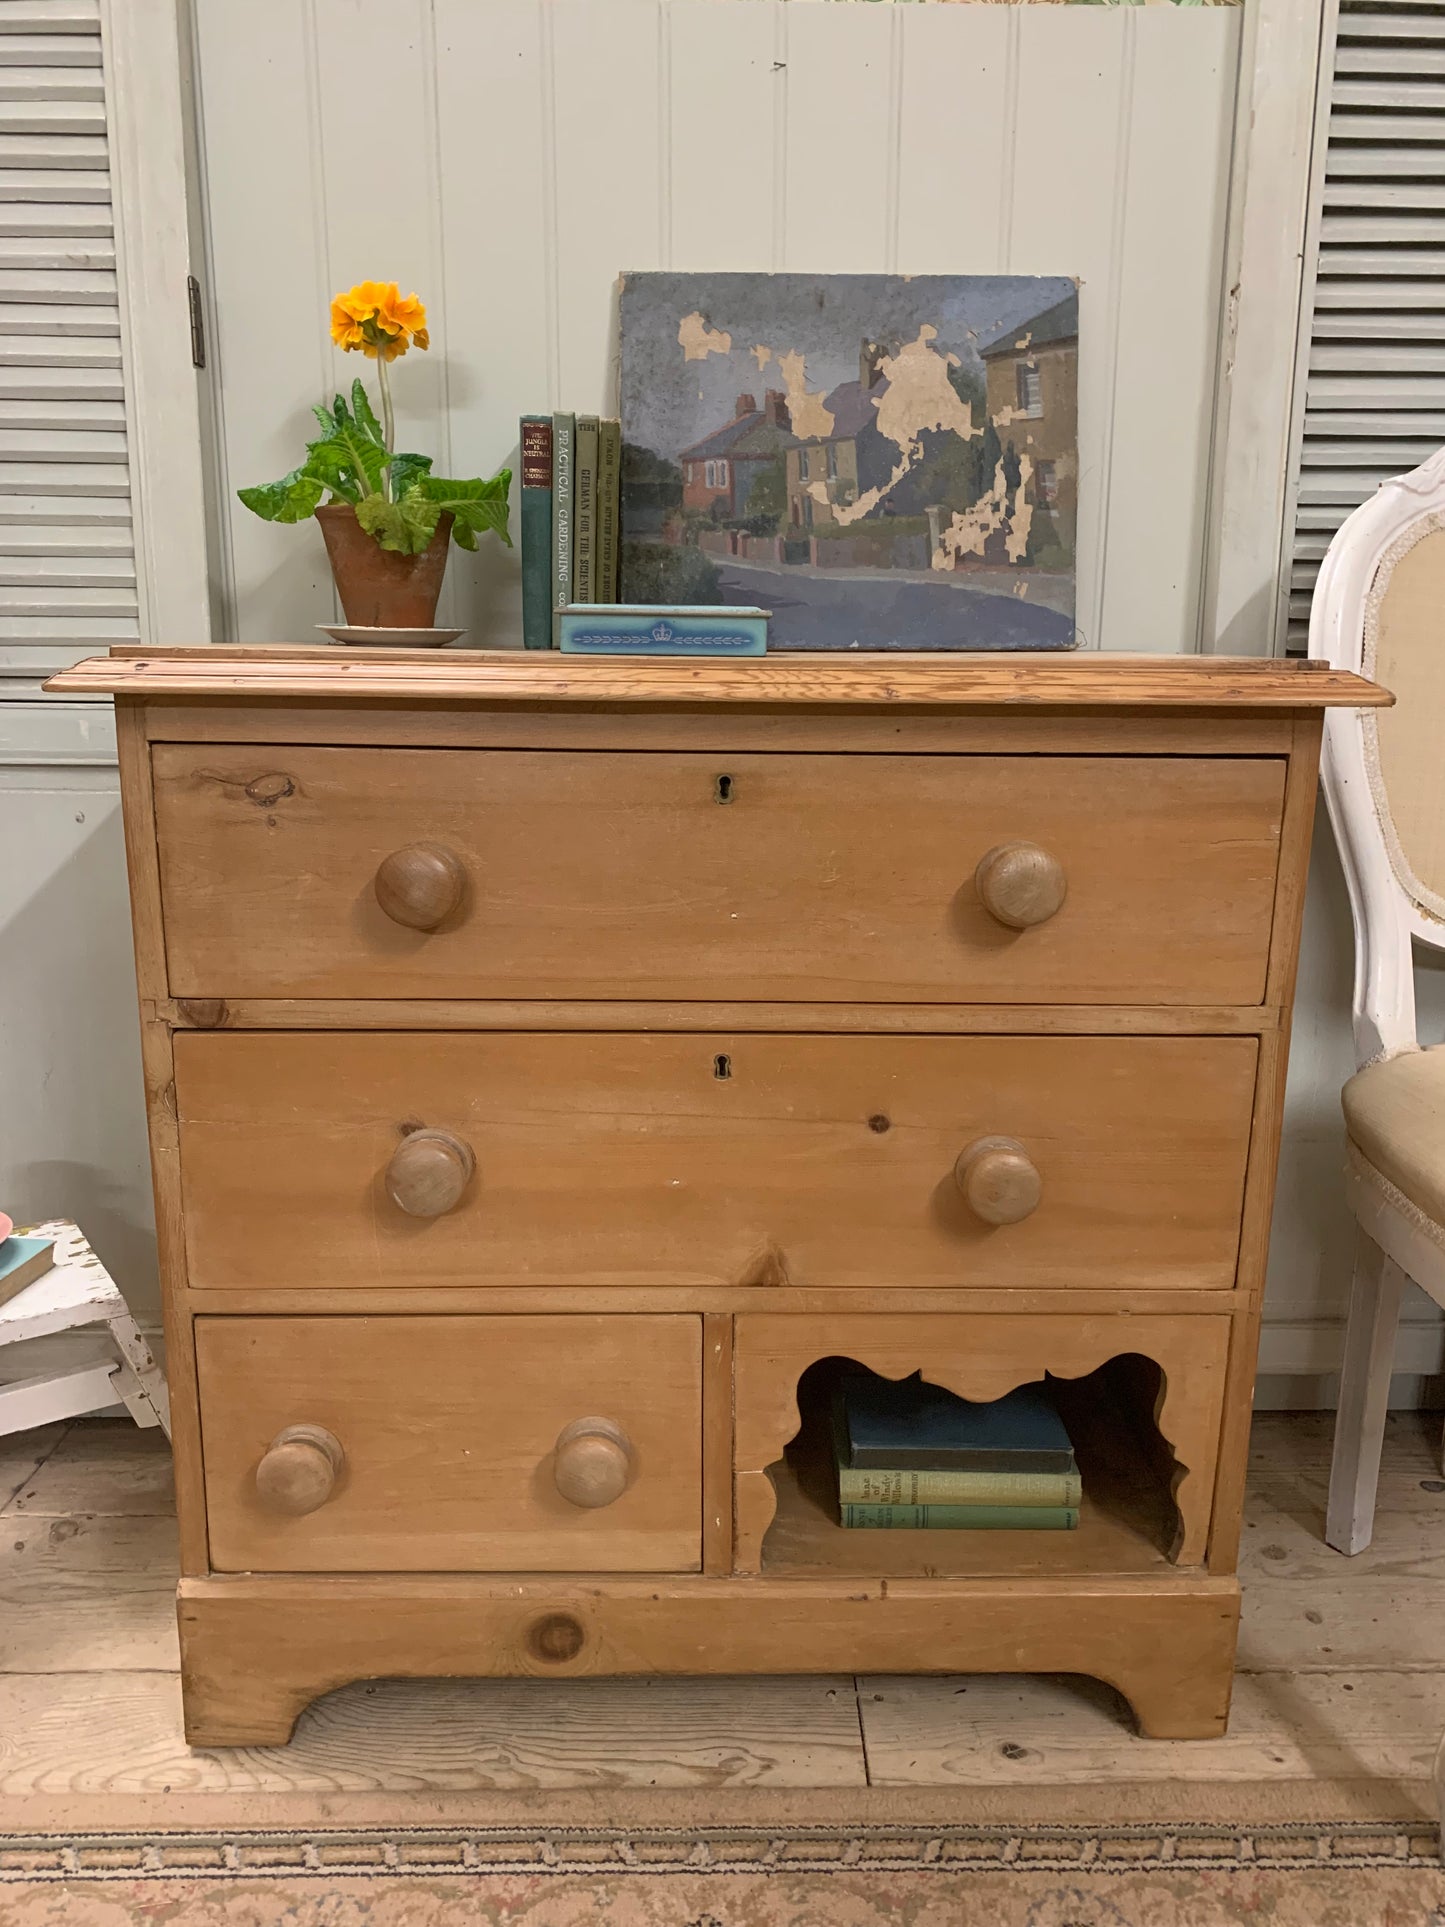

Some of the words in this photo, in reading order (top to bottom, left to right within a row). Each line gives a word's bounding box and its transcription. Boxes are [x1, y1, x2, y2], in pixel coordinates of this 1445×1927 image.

[558, 430, 569, 502] PRACTICAL
[581, 469, 590, 509] GERMAN
[580, 515, 590, 532] FOR
[604, 506, 612, 535] BRITAIN
[558, 509, 569, 581] GARDENING
[580, 537, 589, 555] THE
[604, 538, 612, 560] GREAT
[860, 1478, 870, 1499] Anne
[871, 1484, 880, 1496] of
[881, 1475, 892, 1503] Windy
